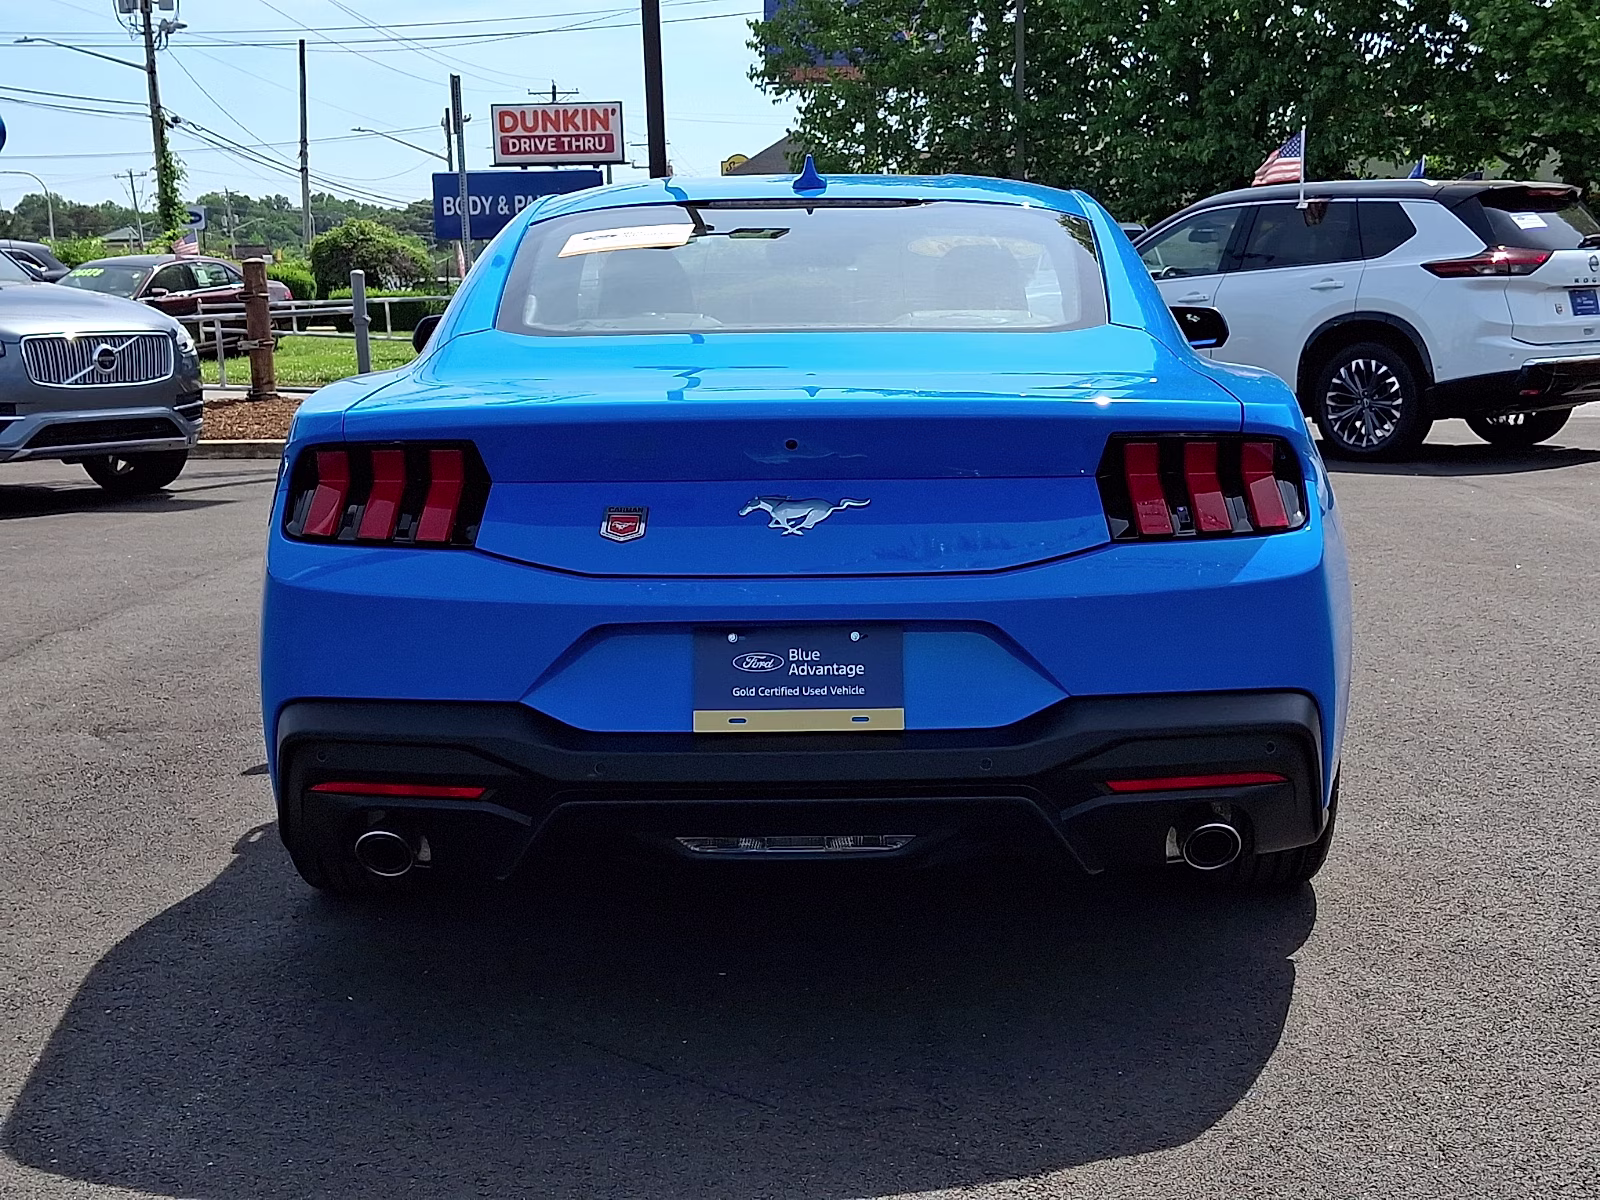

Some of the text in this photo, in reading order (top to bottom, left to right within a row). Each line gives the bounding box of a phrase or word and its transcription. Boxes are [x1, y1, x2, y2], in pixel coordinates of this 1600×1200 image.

[498, 108, 617, 134] DUNKIN'
[508, 136, 606, 153] DRIVE THRU
[497, 195, 510, 215] &
[742, 655, 775, 669] Ford
[789, 648, 821, 661] Blue
[788, 663, 865, 678] Advantage
[732, 685, 865, 697] Gold Certified Used Vehicle
